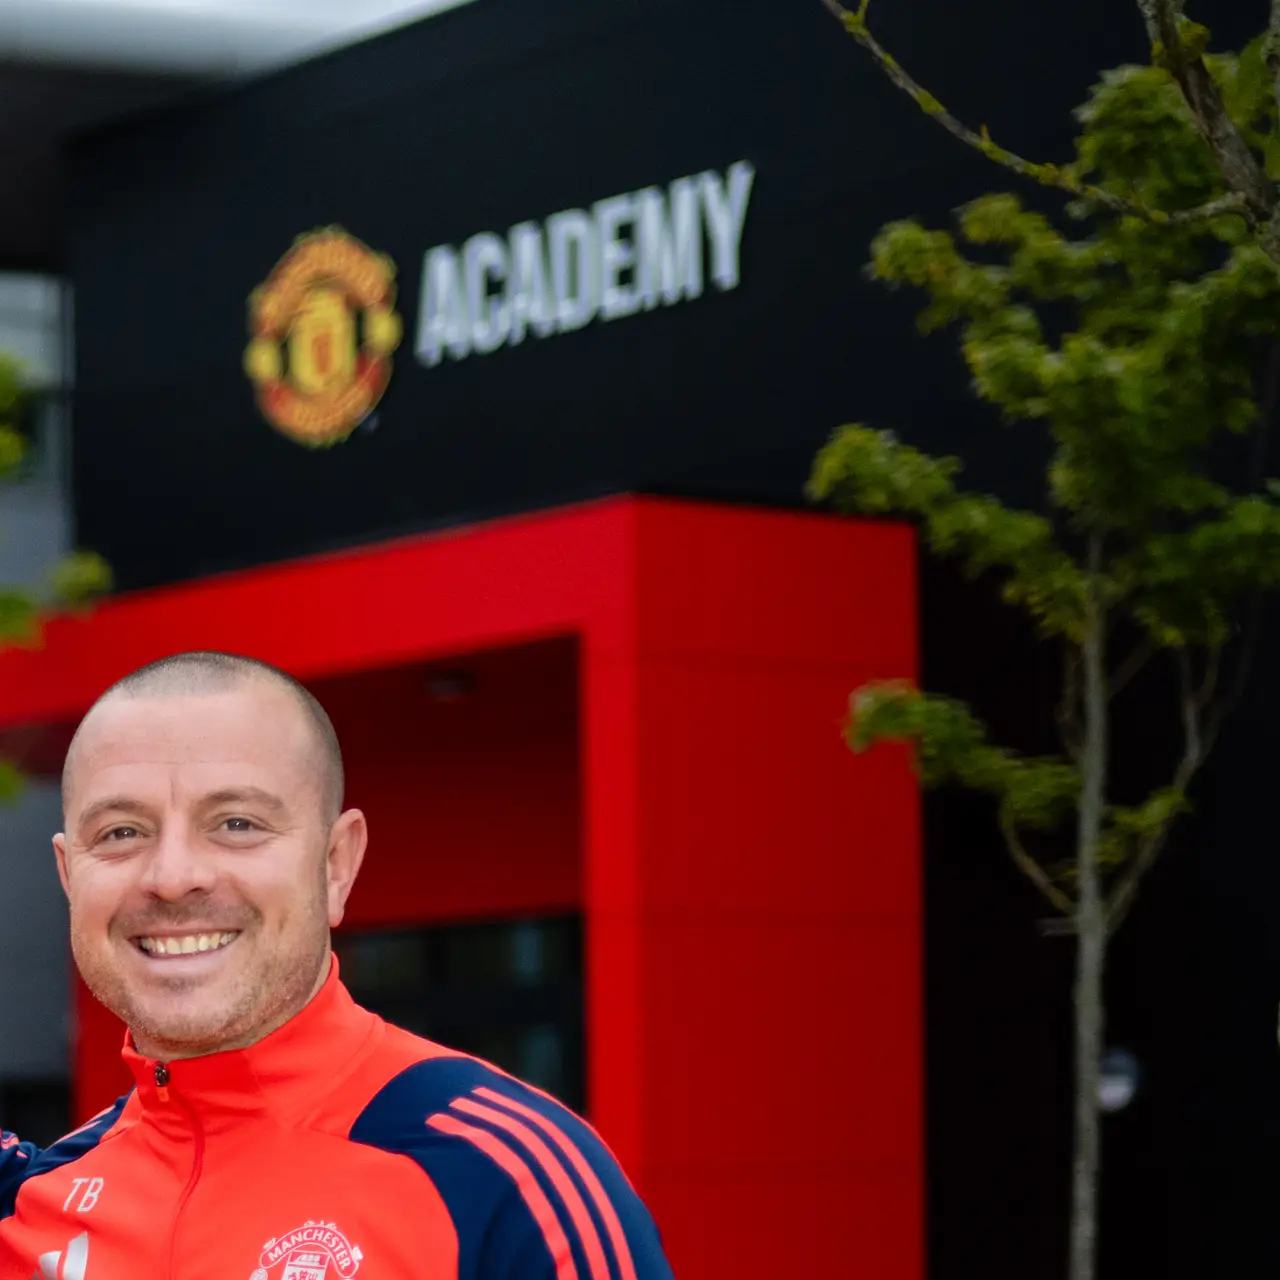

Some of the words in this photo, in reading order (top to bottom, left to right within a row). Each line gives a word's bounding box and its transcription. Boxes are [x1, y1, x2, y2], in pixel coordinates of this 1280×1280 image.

[413, 158, 756, 368] ACADEMY
[63, 1177, 104, 1212] TB
[267, 1229, 351, 1270] MANCHESTER
